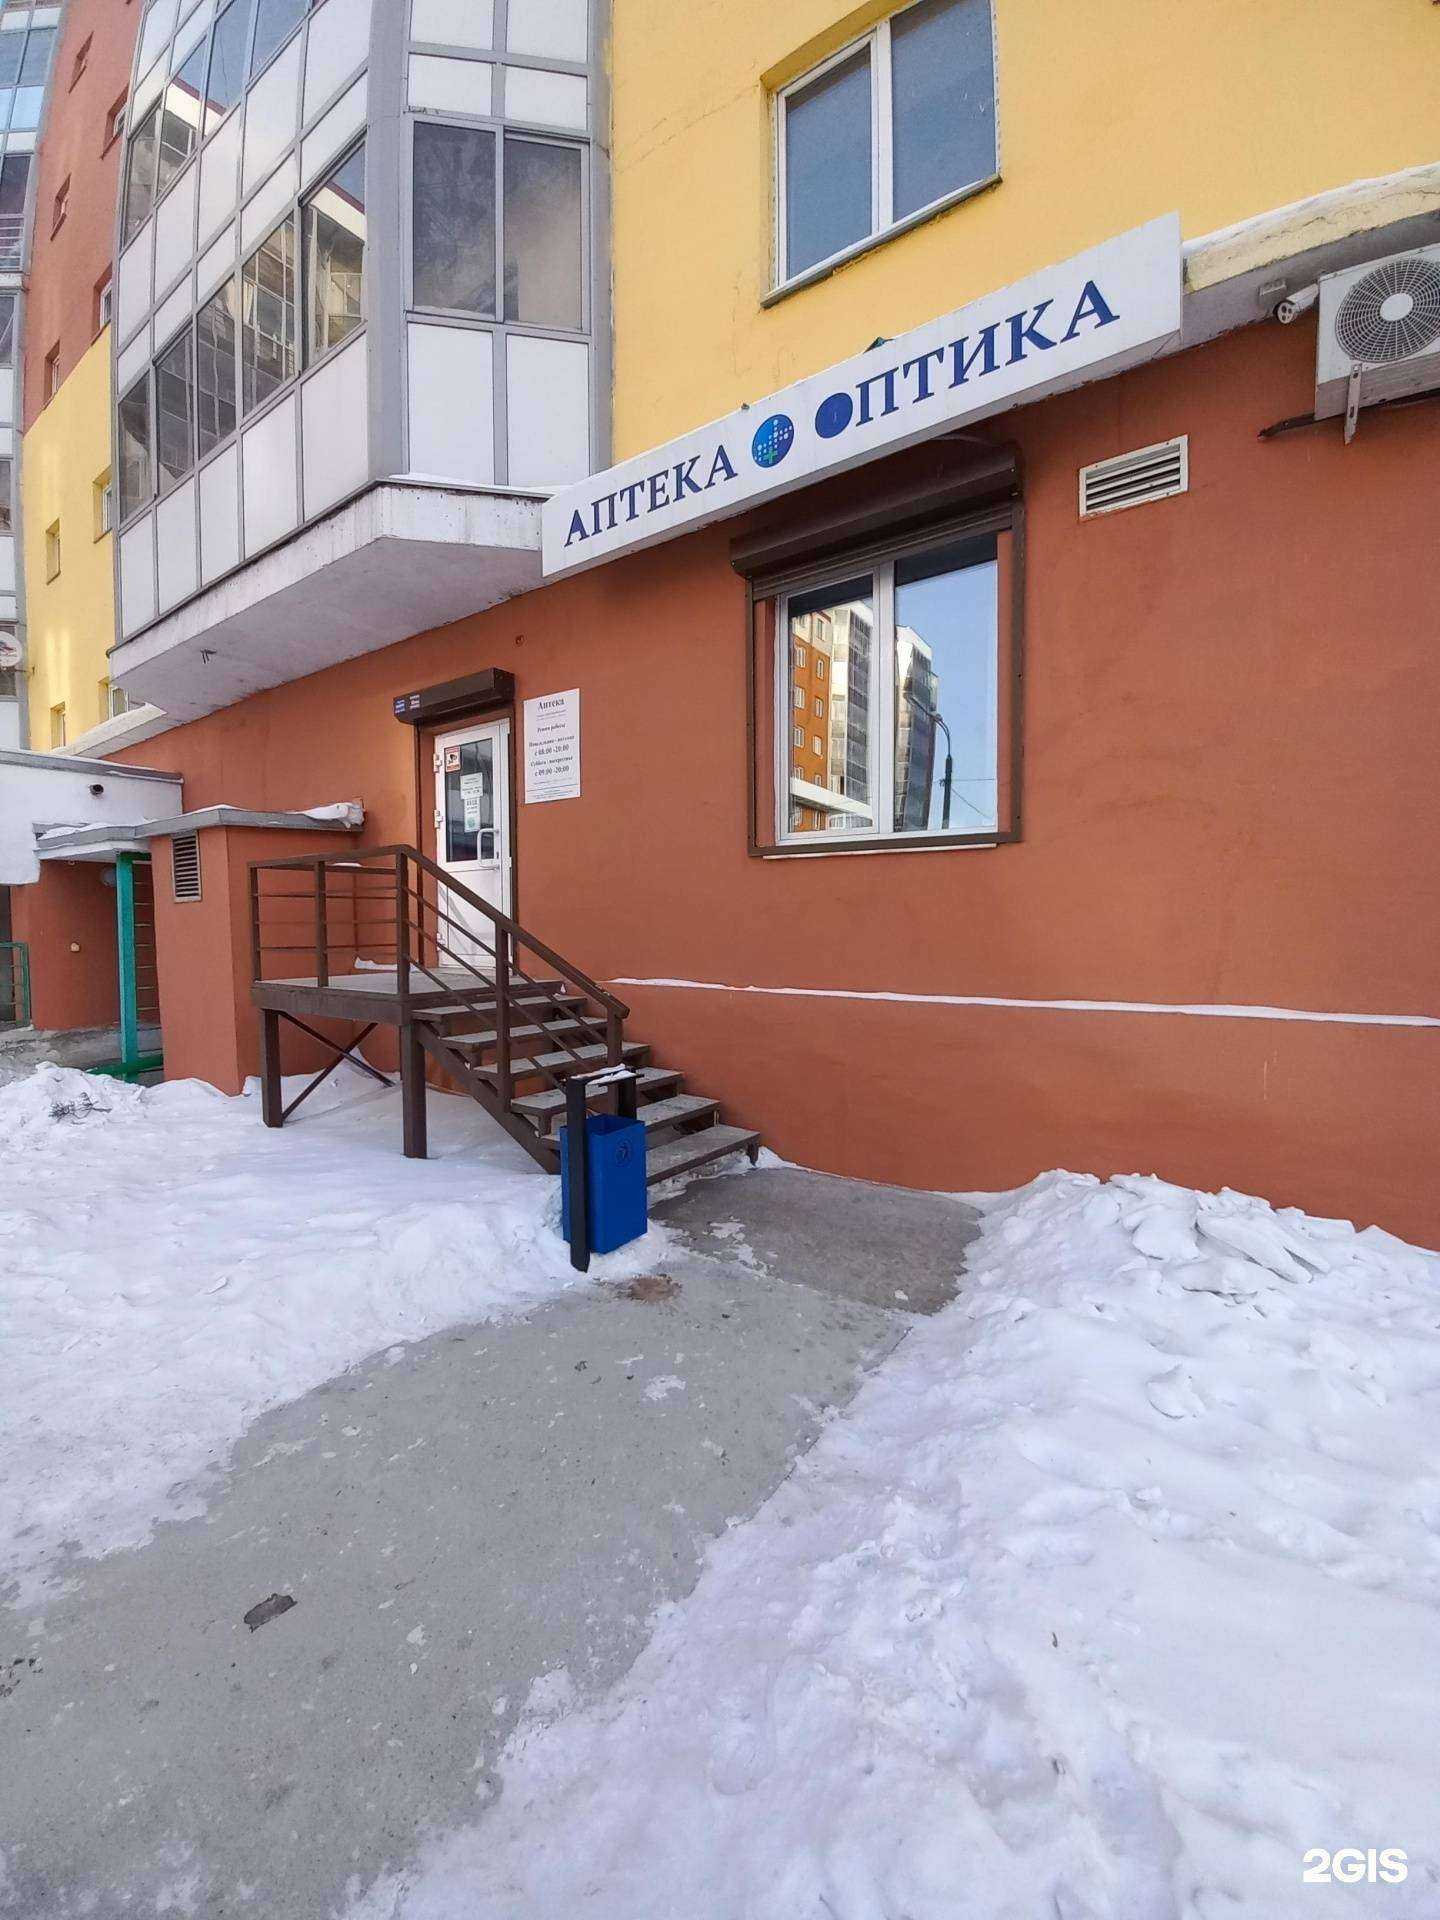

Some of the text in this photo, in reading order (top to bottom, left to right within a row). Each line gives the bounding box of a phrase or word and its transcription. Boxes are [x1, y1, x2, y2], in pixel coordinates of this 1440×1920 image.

[563, 280, 1120, 547] АПТЕКА ОПТИКА
[538, 699, 565, 711] Аптека
